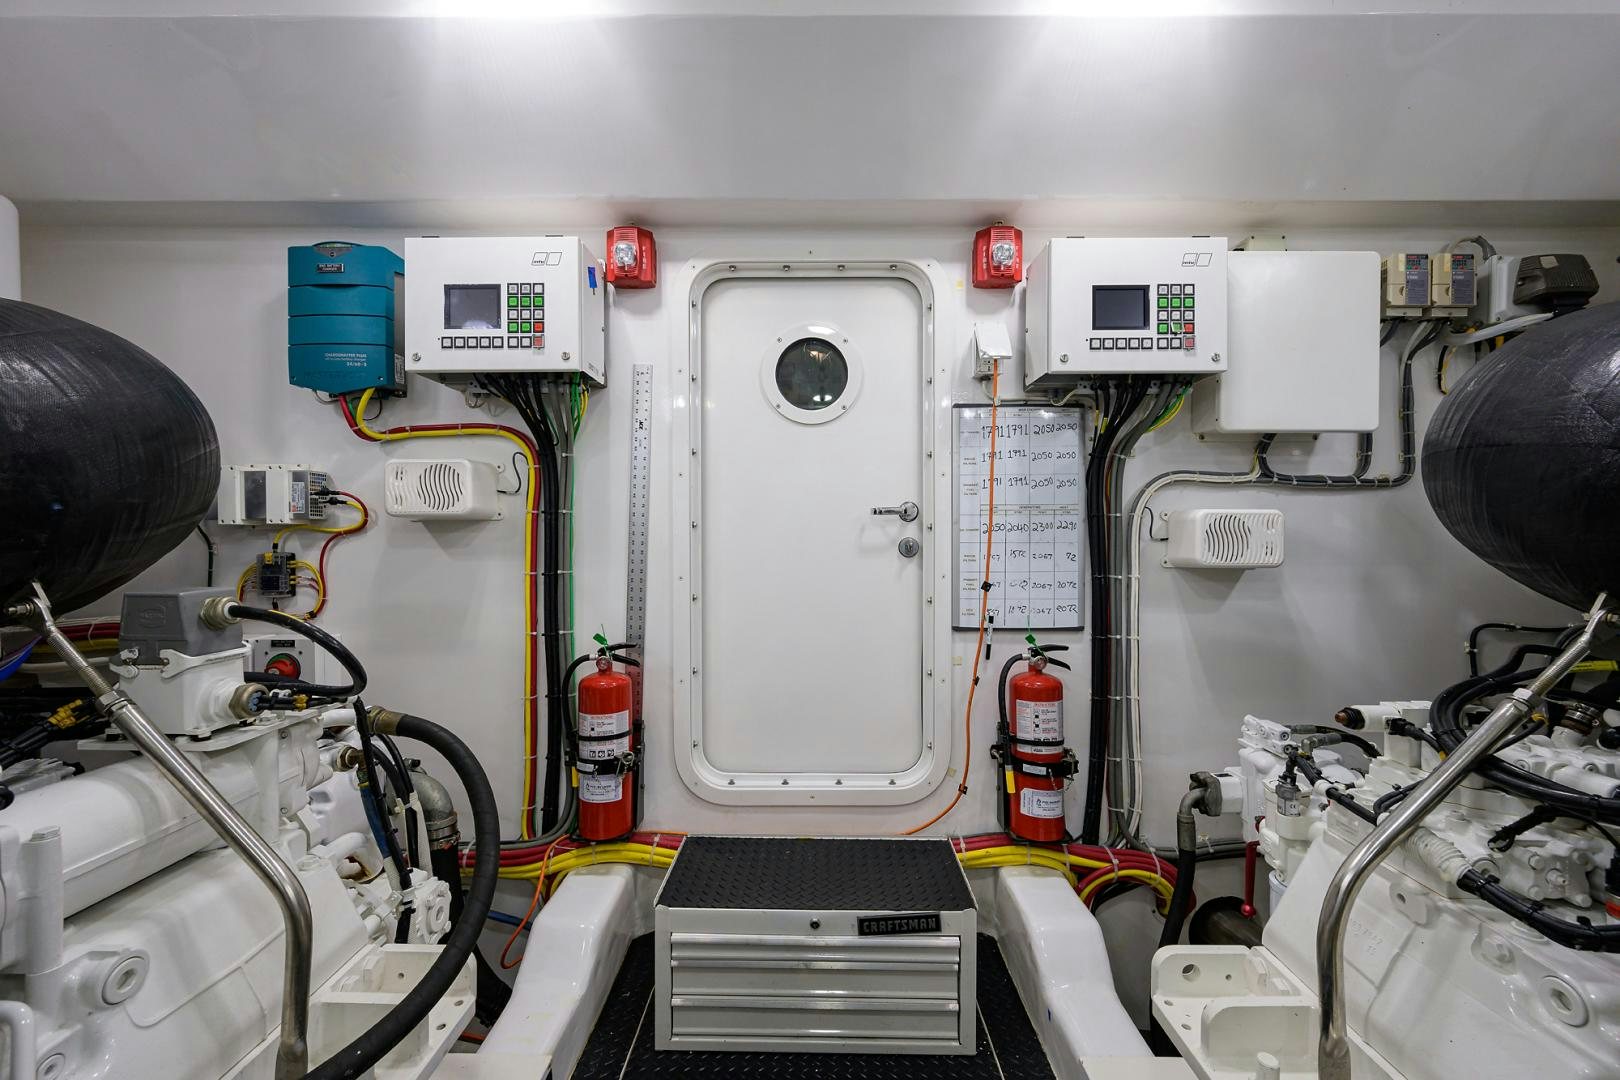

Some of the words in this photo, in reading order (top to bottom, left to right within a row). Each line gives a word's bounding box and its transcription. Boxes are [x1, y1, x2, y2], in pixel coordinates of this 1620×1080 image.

[1006, 424, 1029, 438] 1791
[1033, 424, 1055, 436] 2050
[1056, 422, 1078, 432] 2050
[1031, 451, 1053, 462] 2050
[1056, 451, 1077, 460] 2050
[1008, 476, 1029, 487] 1791
[1031, 476, 1053, 489] 2050
[1007, 522, 1029, 533] 2040
[863, 918, 937, 933] CRAFTSMAN
